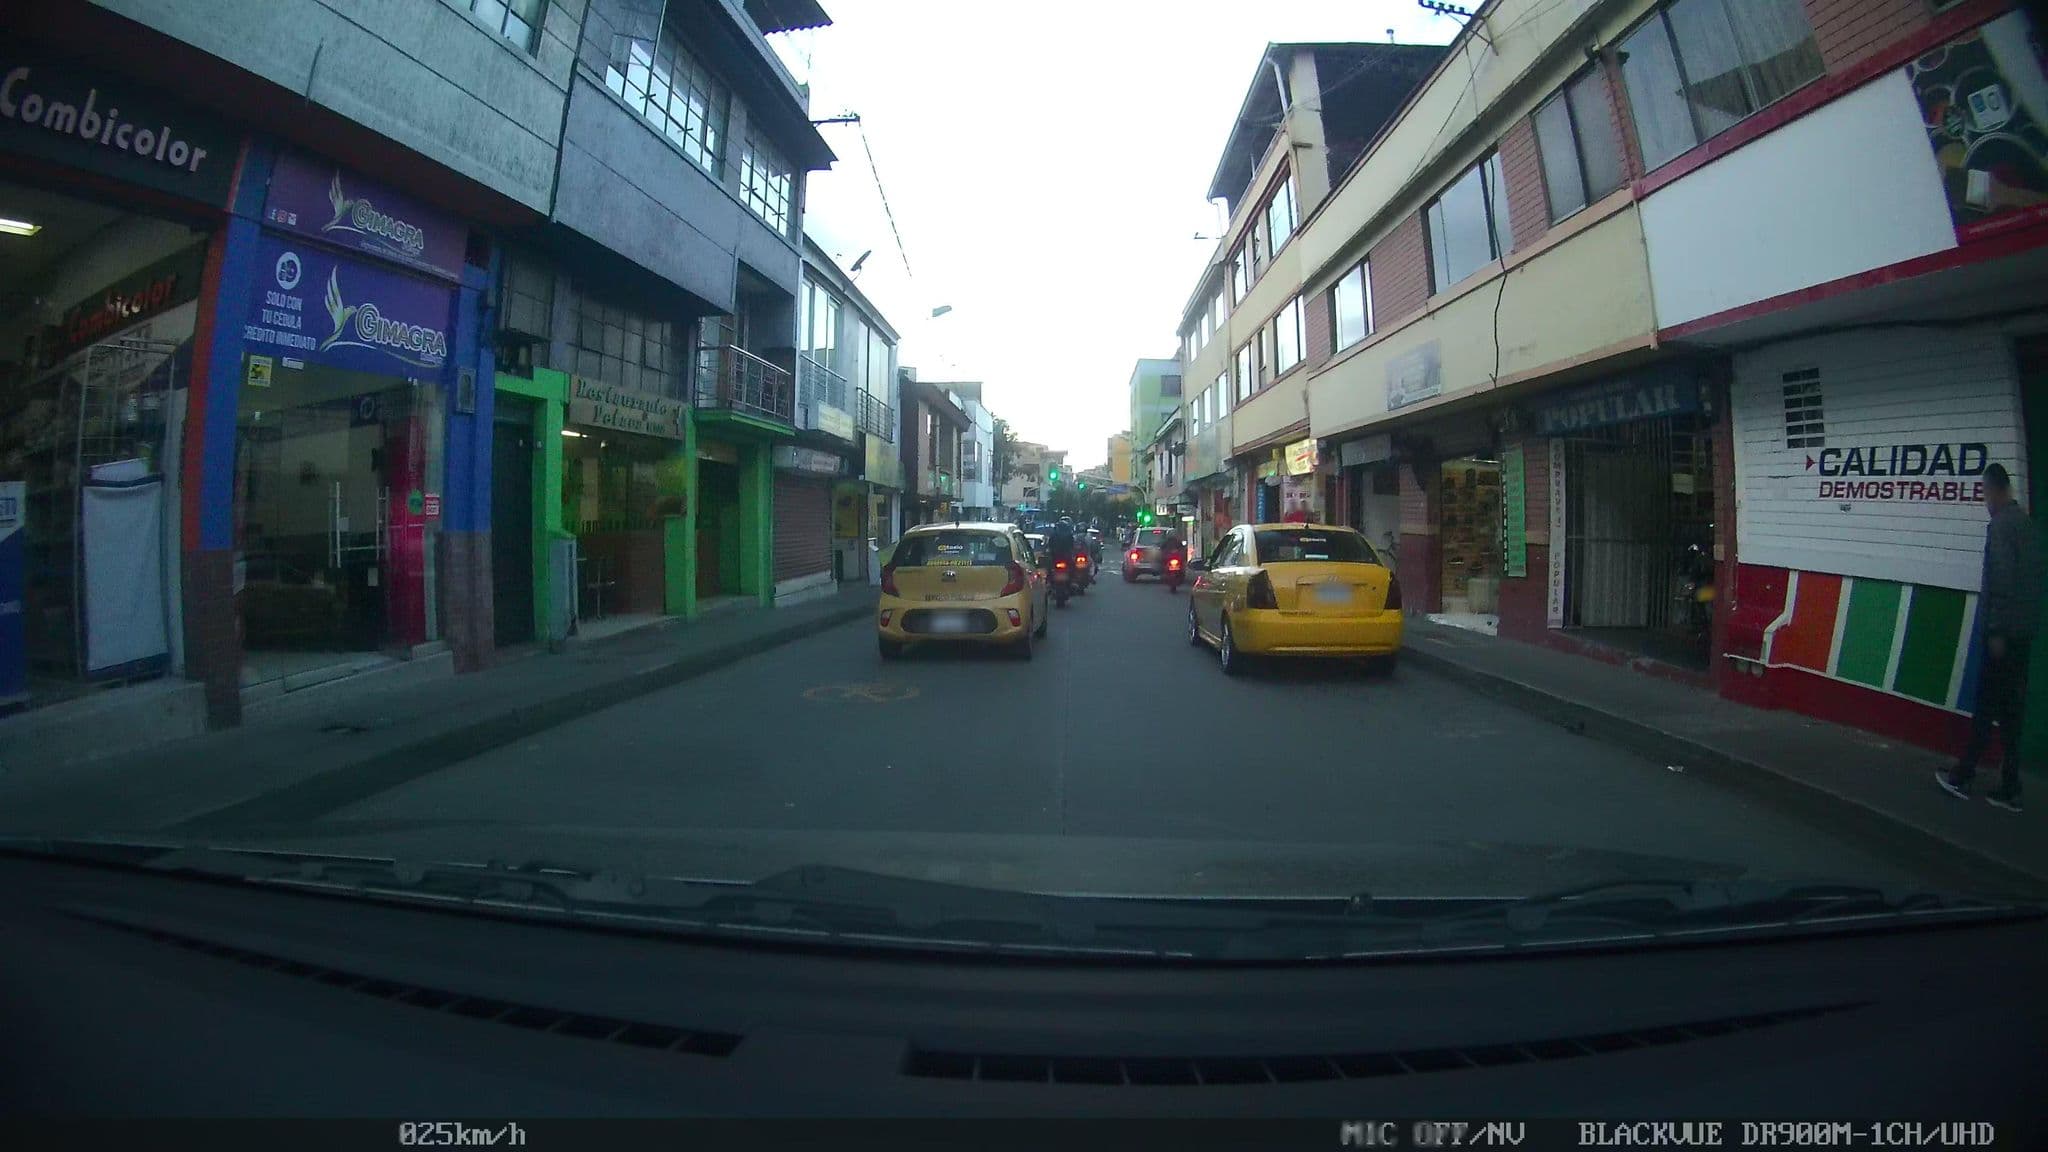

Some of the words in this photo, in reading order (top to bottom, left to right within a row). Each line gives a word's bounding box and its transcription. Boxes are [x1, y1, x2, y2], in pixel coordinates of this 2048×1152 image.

[0, 66, 208, 173] Combicolor
[352, 199, 424, 250] GIMAGRA
[266, 290, 286, 308] SOLO
[355, 303, 447, 358] GIMAGRA
[1819, 443, 1987, 477] CALIDAD
[1819, 480, 1985, 502] DEMOSTRABLE
